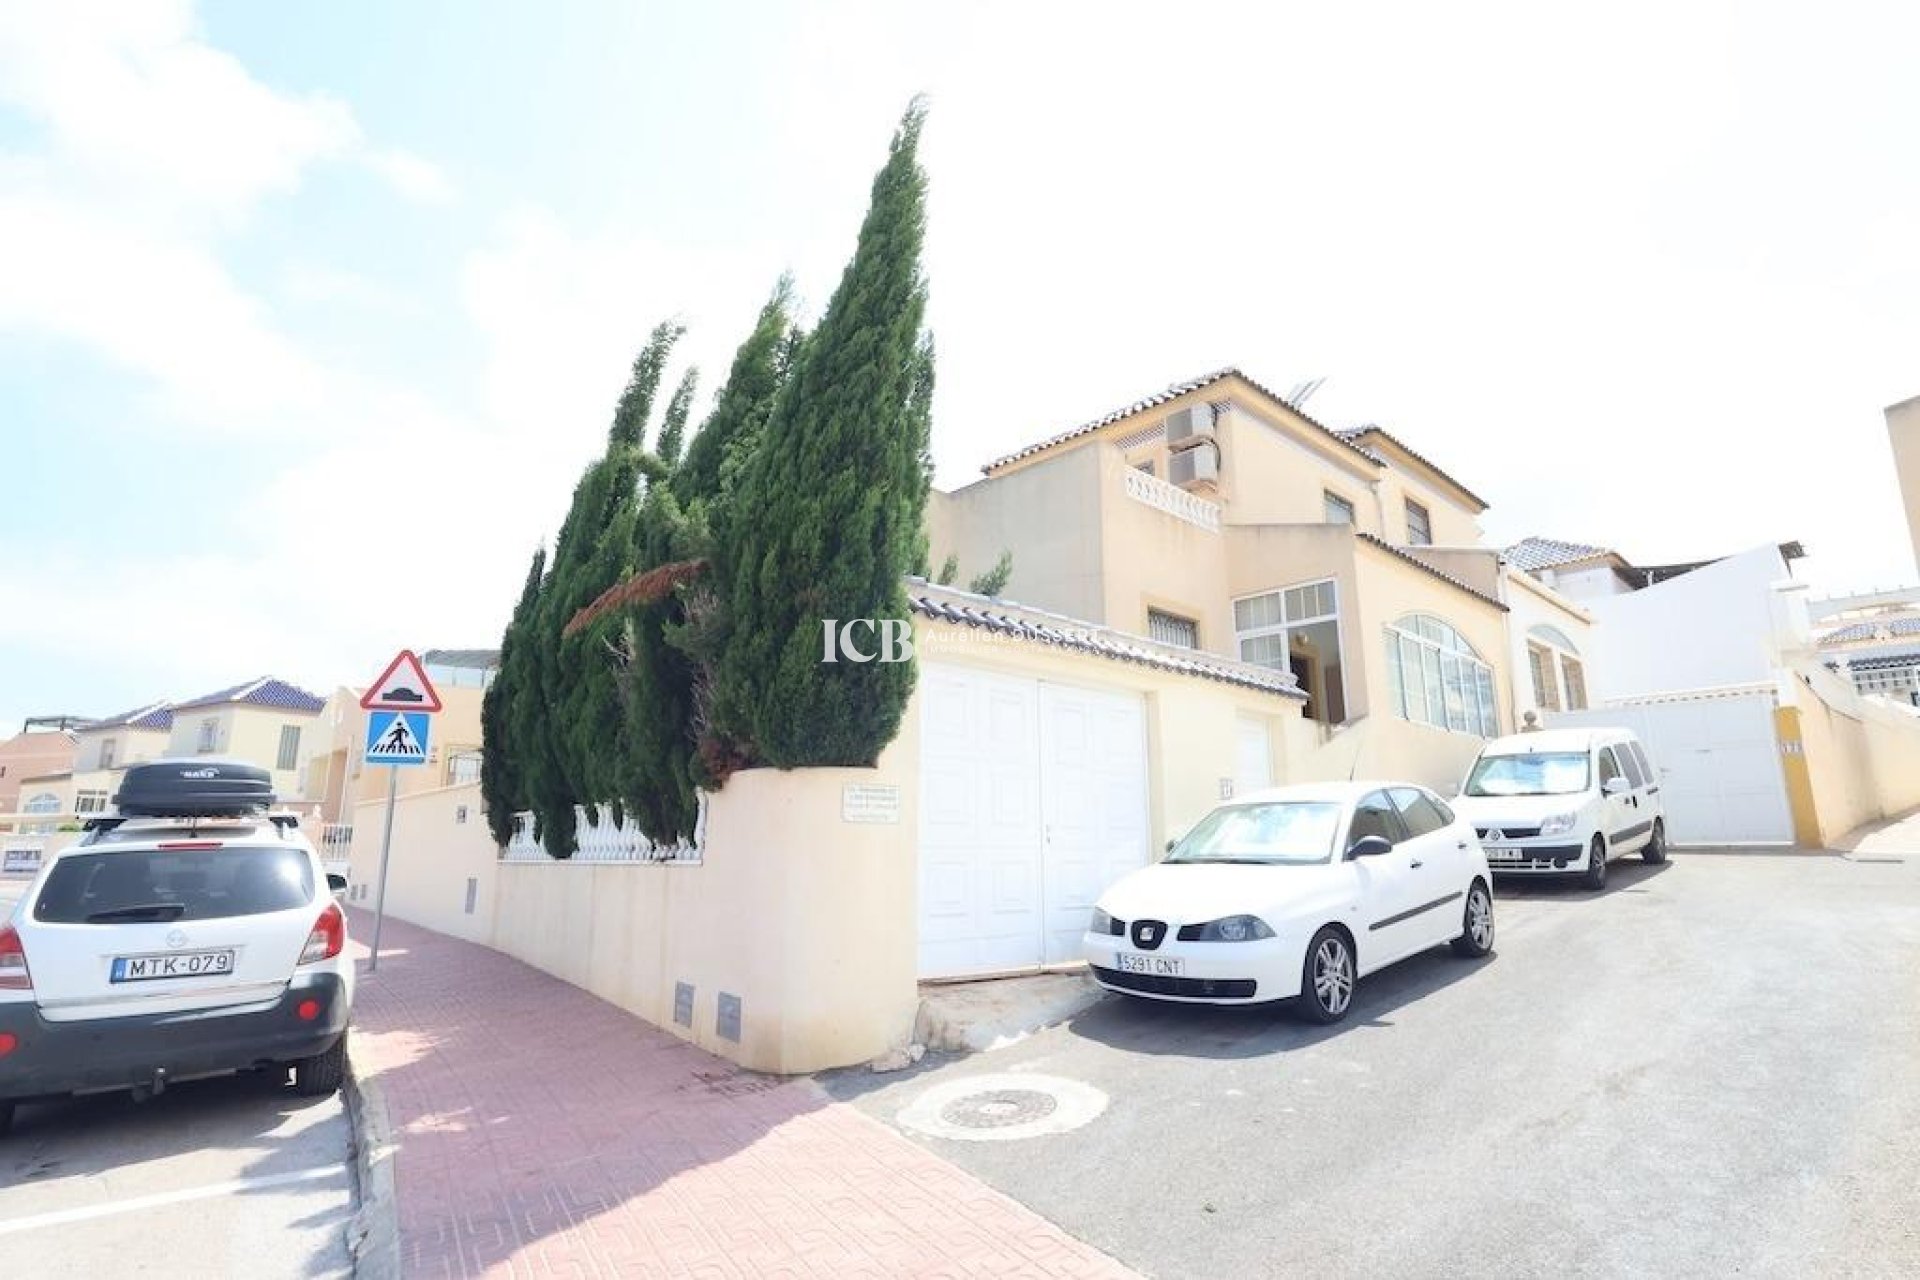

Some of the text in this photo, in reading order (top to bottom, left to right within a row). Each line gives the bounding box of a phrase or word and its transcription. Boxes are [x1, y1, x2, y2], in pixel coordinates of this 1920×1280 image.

[130, 955, 228, 976] MTK-079
[1124, 955, 1180, 974] 5291 CNT
